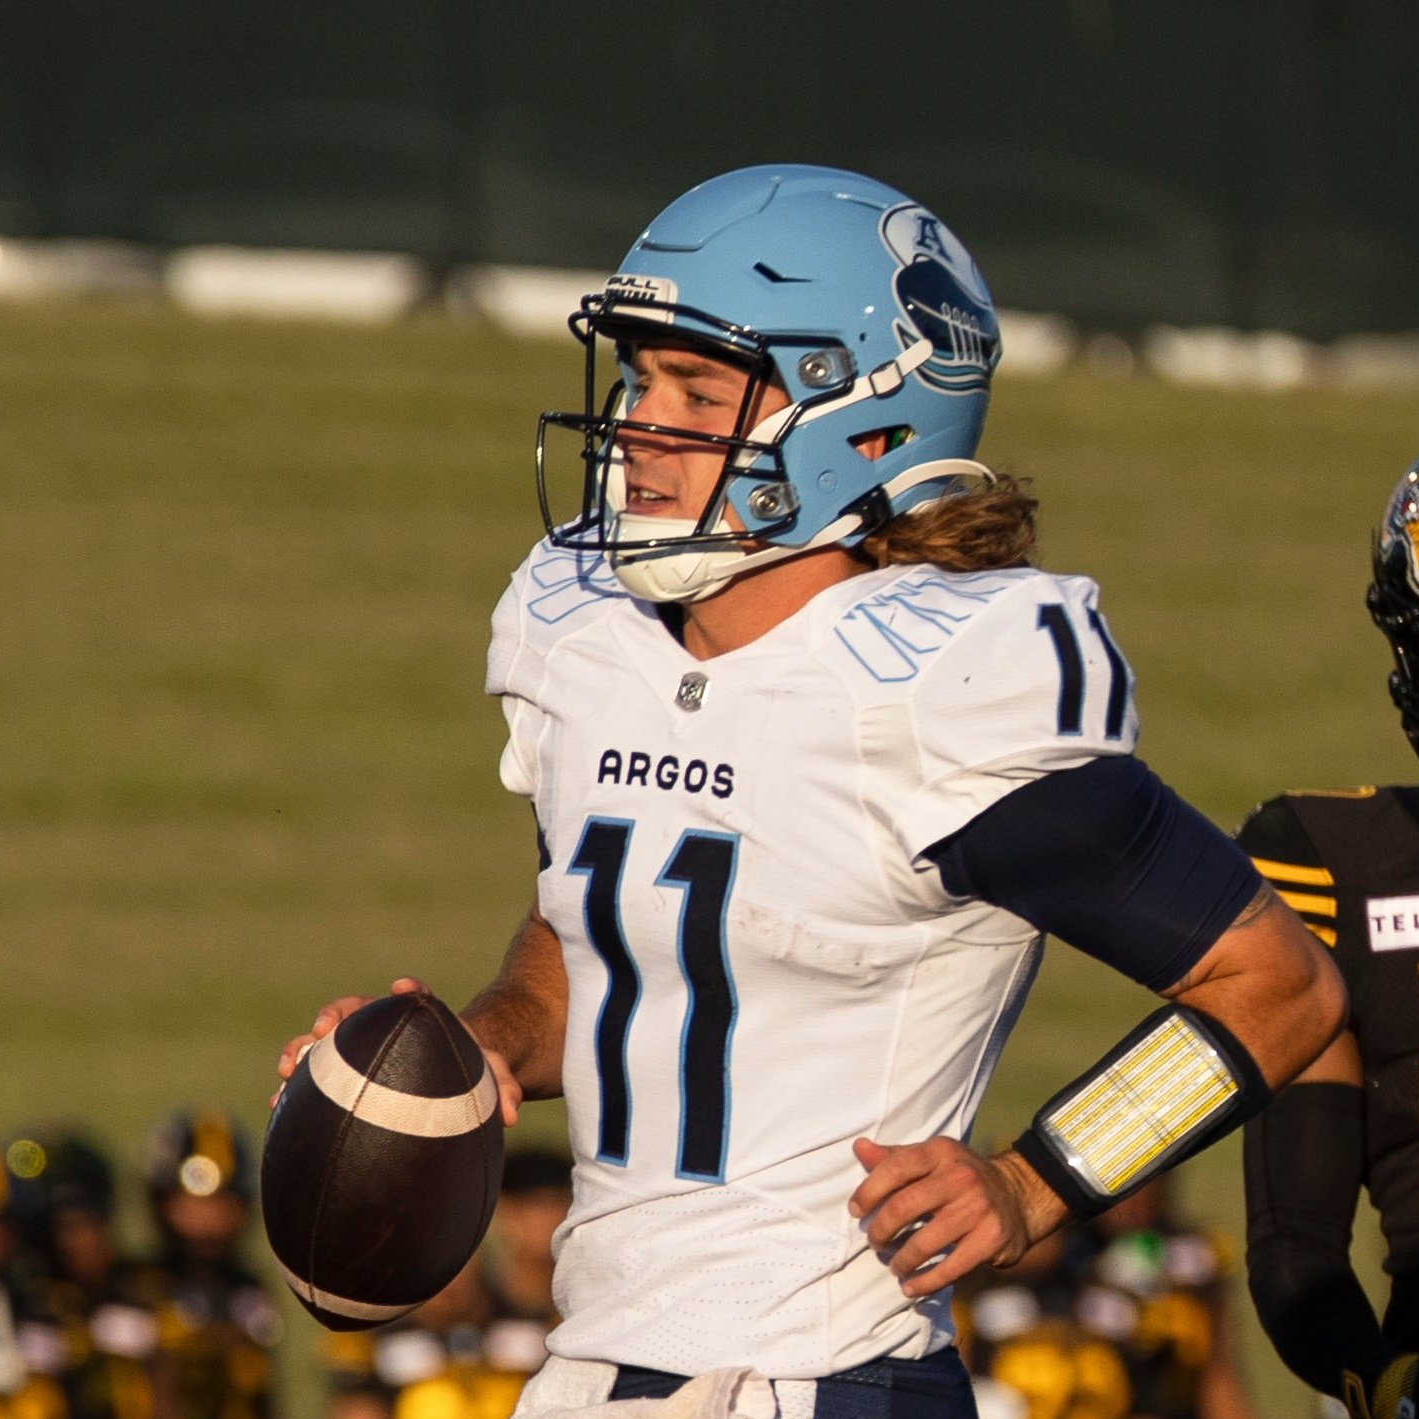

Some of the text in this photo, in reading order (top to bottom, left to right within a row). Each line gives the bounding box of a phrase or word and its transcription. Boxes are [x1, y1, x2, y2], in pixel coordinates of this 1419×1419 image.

[1036, 602, 1133, 741] 11
[597, 749, 736, 799] ARGOS
[566, 814, 742, 1186] 11
